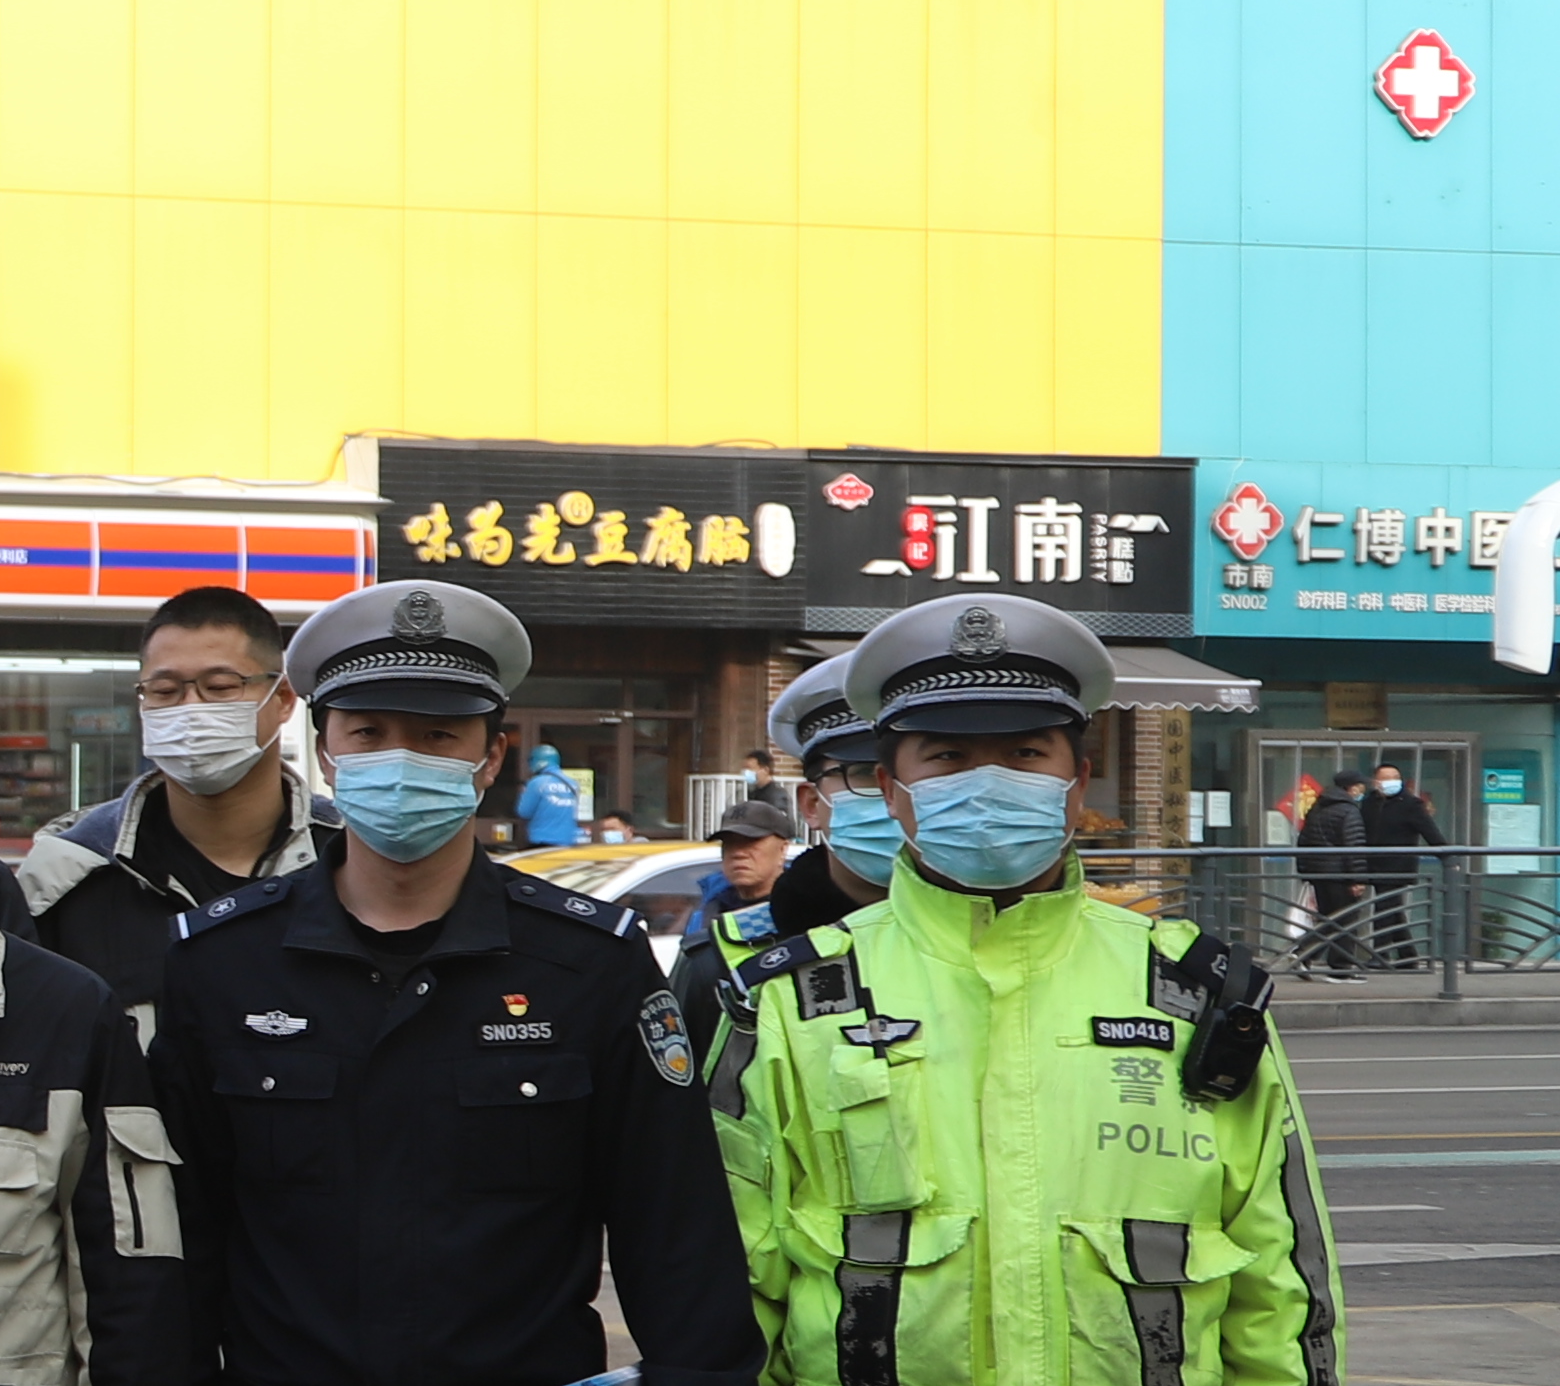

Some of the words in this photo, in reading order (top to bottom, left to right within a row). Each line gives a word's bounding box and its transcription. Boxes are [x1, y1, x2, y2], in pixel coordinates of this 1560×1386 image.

[1293, 505, 1518, 568] 仁博中医
[1223, 563, 1275, 590] 市南
[1220, 594, 1268, 611] SN002
[482, 1022, 553, 1043] SN0355
[1098, 1021, 1171, 1043] SN0418
[1110, 1056, 1214, 1114] 警
